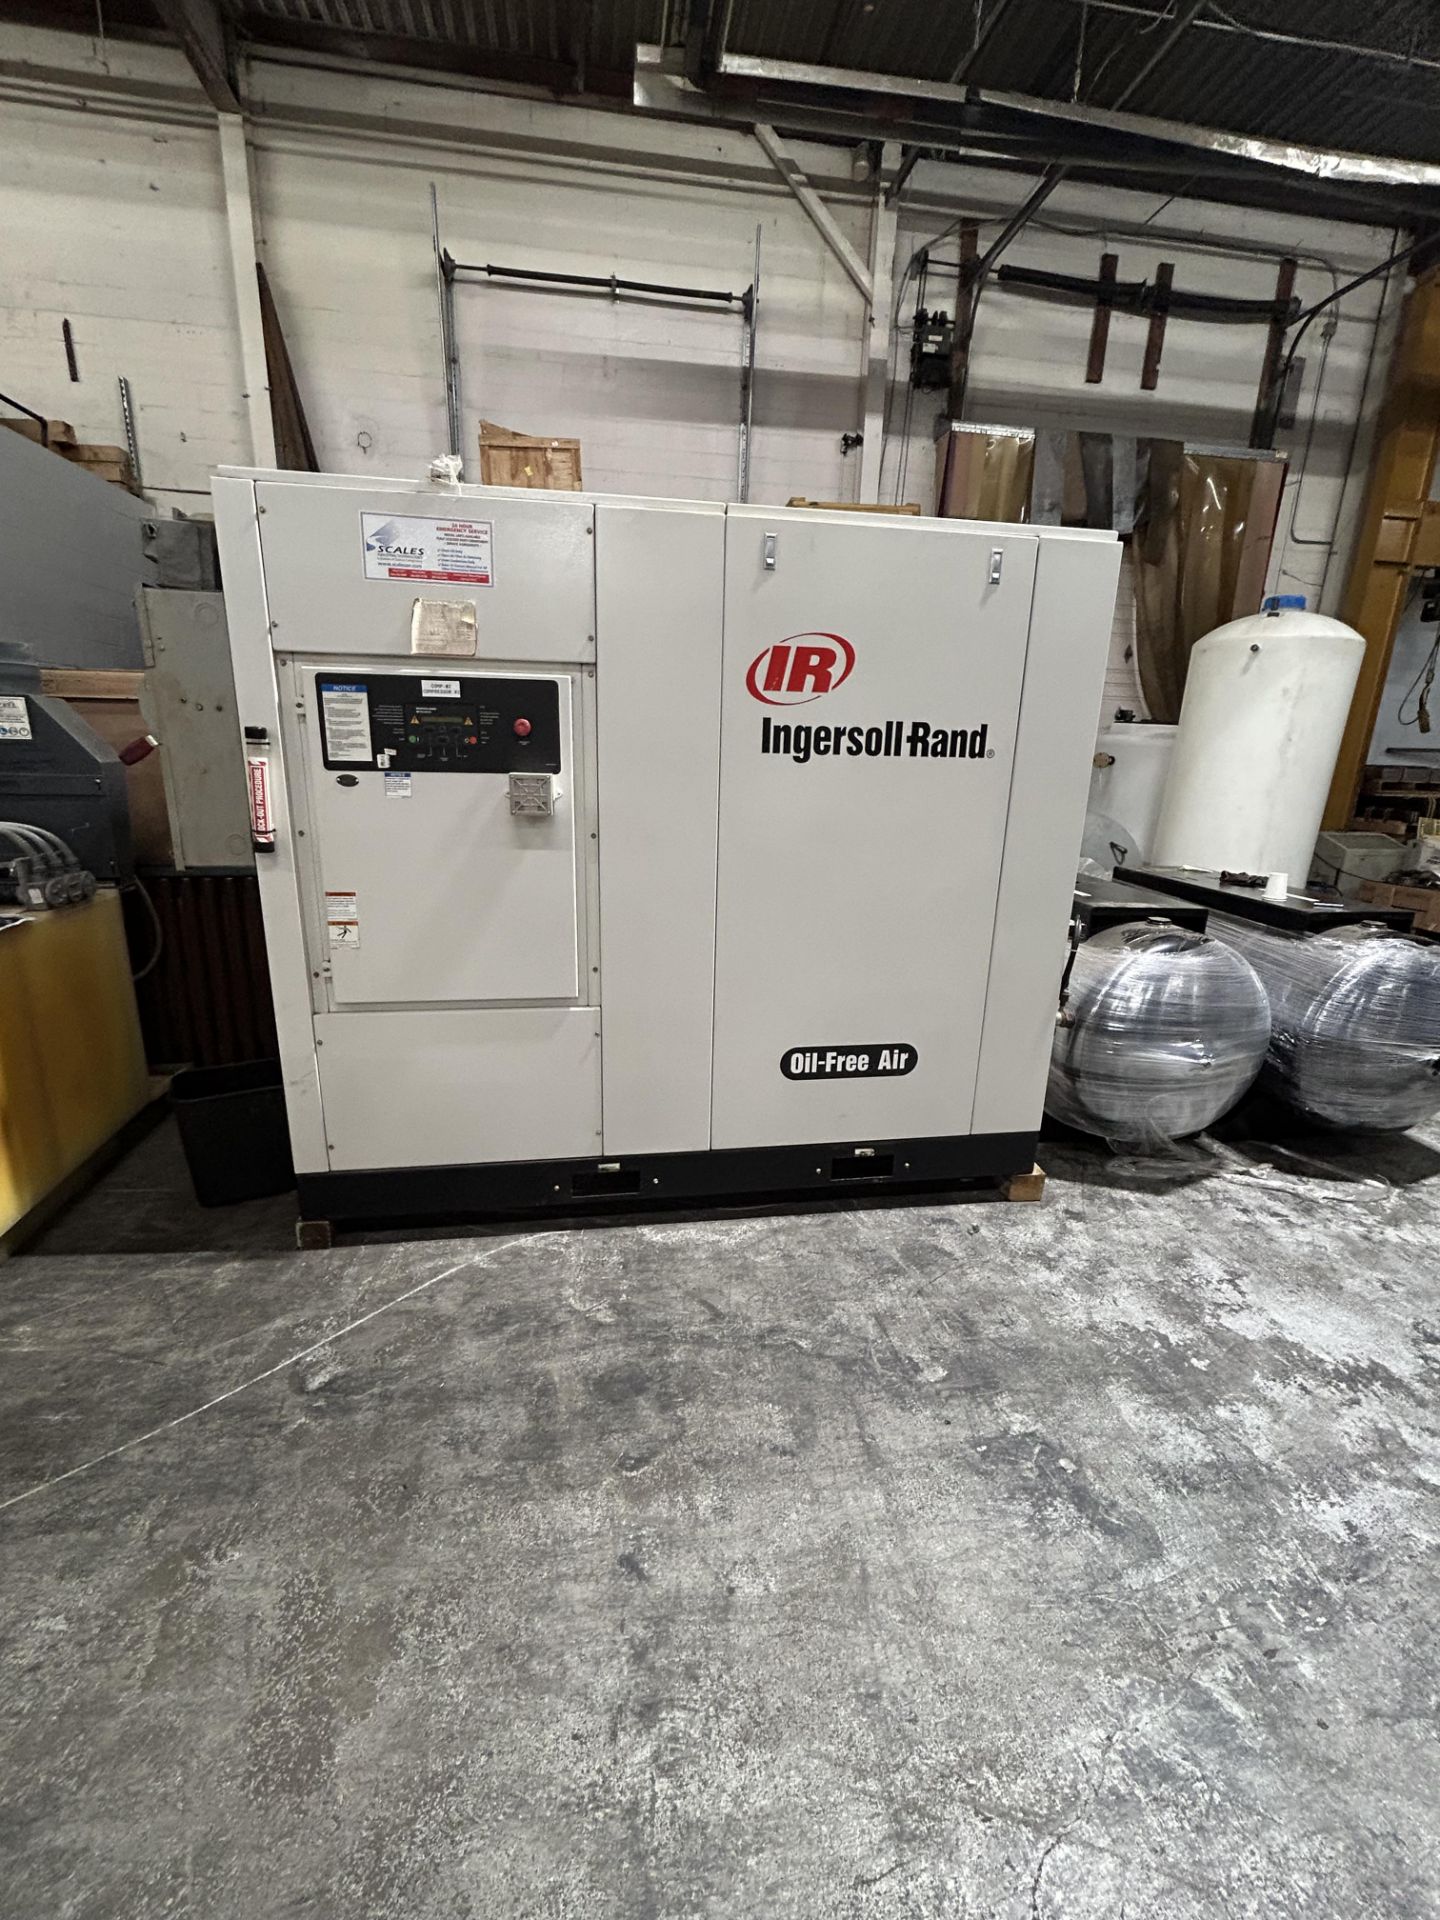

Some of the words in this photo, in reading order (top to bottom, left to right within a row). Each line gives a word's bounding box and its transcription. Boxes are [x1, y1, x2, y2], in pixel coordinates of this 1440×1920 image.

[377, 545, 425, 556] SCALES
[763, 645, 837, 693] IR
[253, 768, 264, 804] PROCEDURE
[255, 804, 266, 833] OCK-OUT
[790, 1052, 870, 1074] Oil-Free
[878, 1049, 909, 1070] Air
